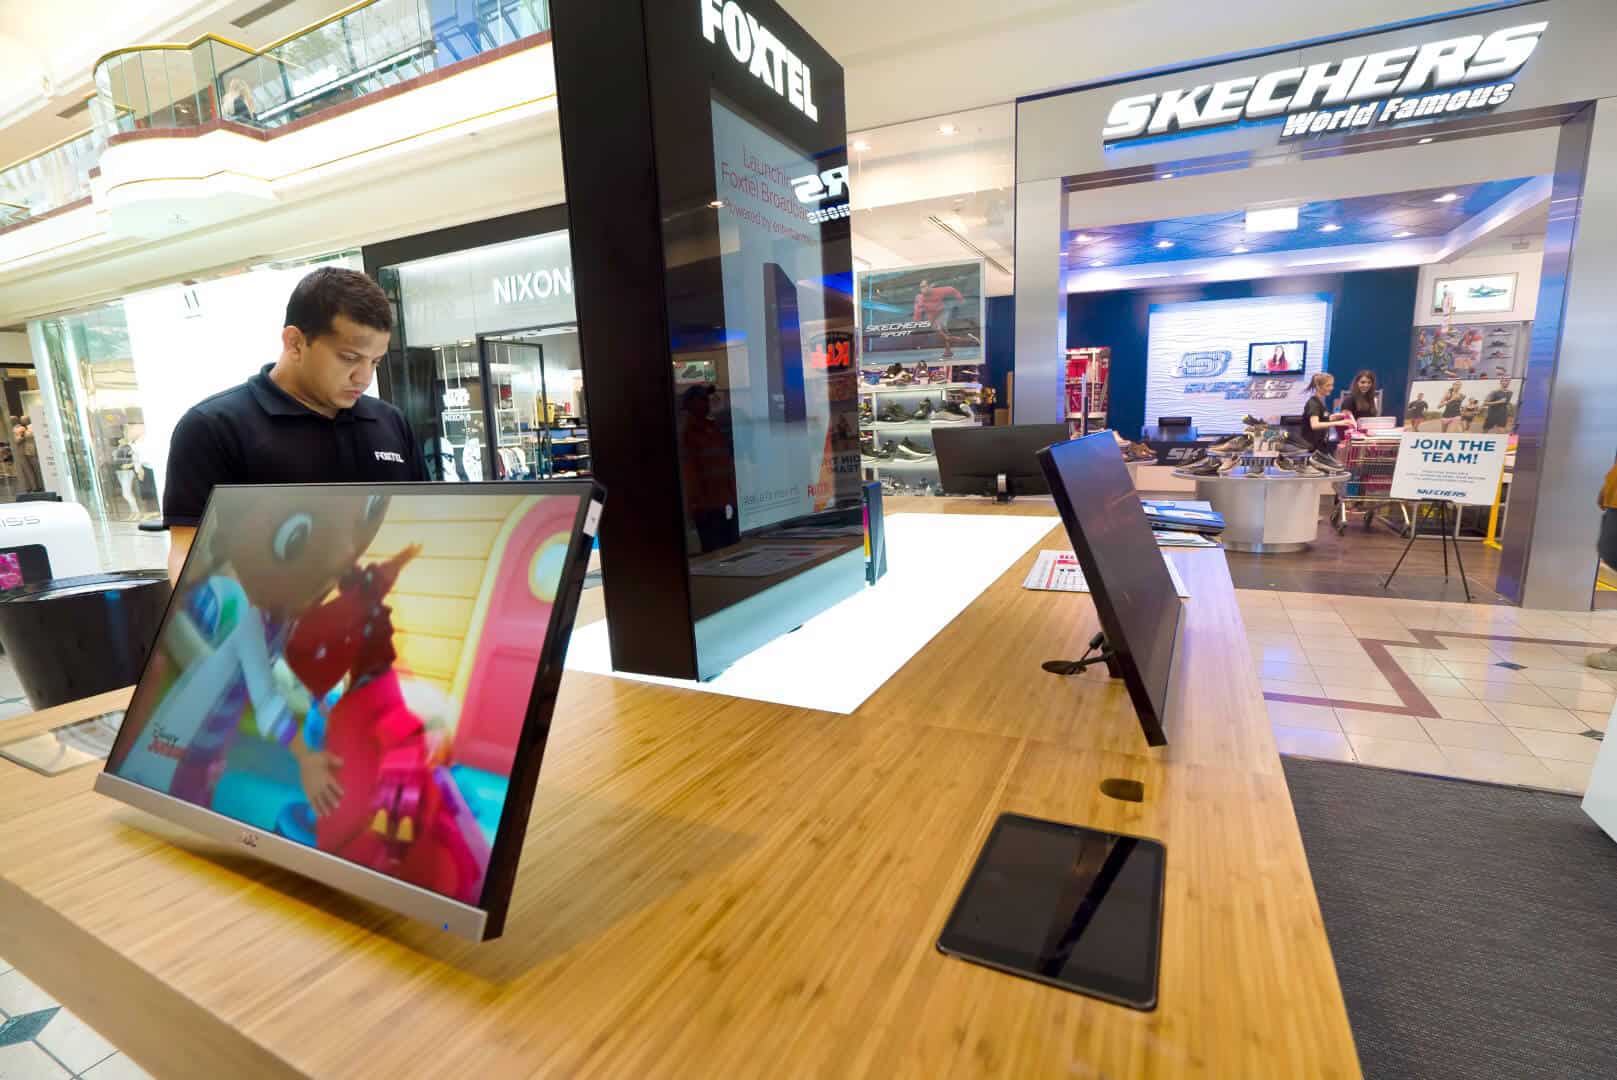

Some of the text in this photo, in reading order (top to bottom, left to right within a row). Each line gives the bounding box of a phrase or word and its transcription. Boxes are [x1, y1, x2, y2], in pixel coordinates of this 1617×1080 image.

[700, 0, 818, 122] FOXTEL
[1102, 21, 1548, 139] SKECHERS
[1282, 84, 1516, 137] World Famous
[494, 267, 573, 304] NIXON
[1411, 439, 1496, 452] JOIN THE
[1422, 451, 1478, 464] TEAM!
